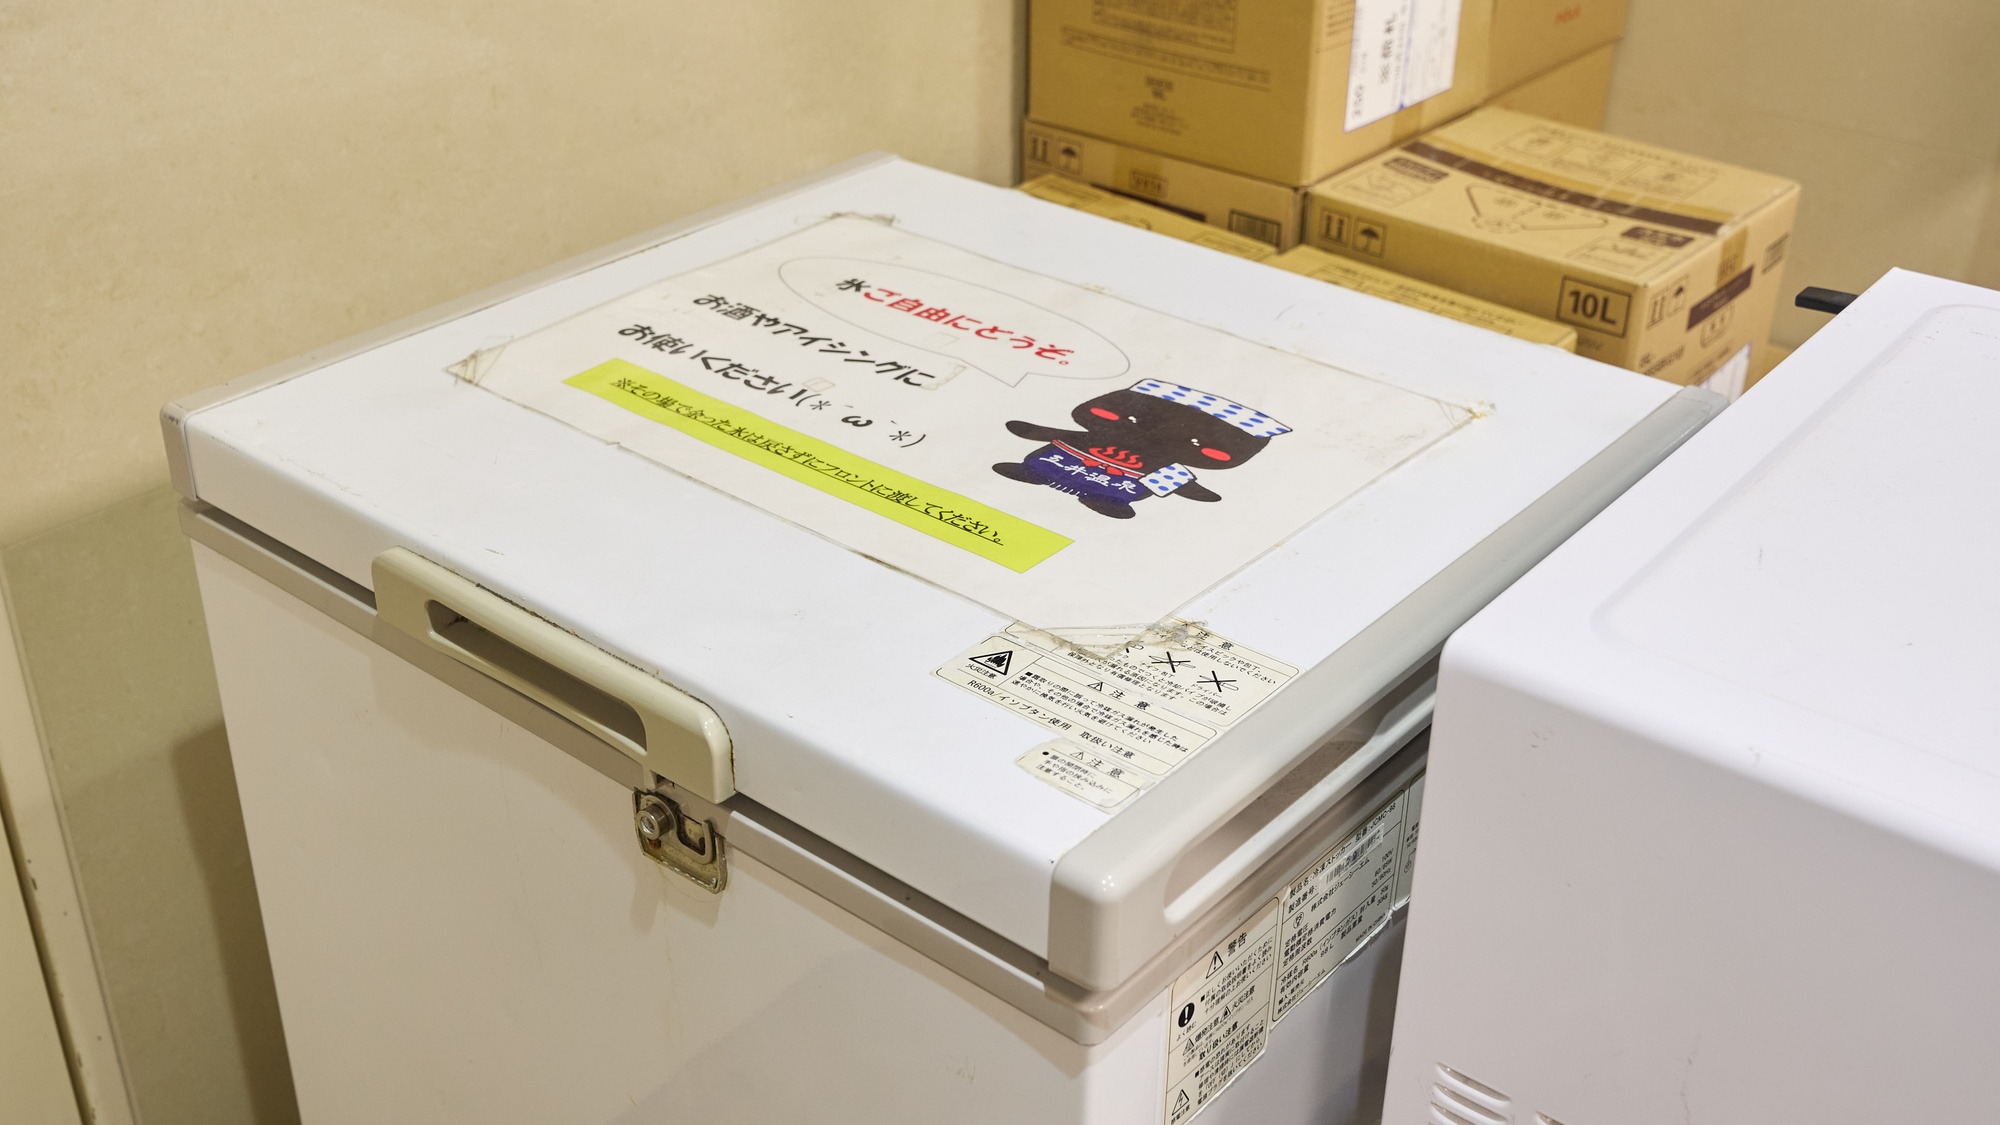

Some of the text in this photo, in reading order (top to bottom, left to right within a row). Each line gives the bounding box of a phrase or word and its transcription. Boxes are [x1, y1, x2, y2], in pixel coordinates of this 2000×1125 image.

[836, 277, 1071, 366] 氷ご自由にどうぞ。
[1569, 288, 1617, 326] 10L
[693, 293, 936, 388] お酒やアイシングに
[611, 377, 1002, 544] ※その場で余った氷は戻さずにフロントに渡してください。
[964, 663, 997, 679] 火災注意
[1189, 683, 1223, 698] ドライバー
[1077, 730, 1136, 759] 取扱い注意
[1035, 763, 1086, 790] 注意すること。
[1310, 854, 1369, 913] 株式会社ジェーシーエム
[1228, 933, 1246, 957] 警告
[1198, 1019, 1238, 1061] 取り扱い注意
